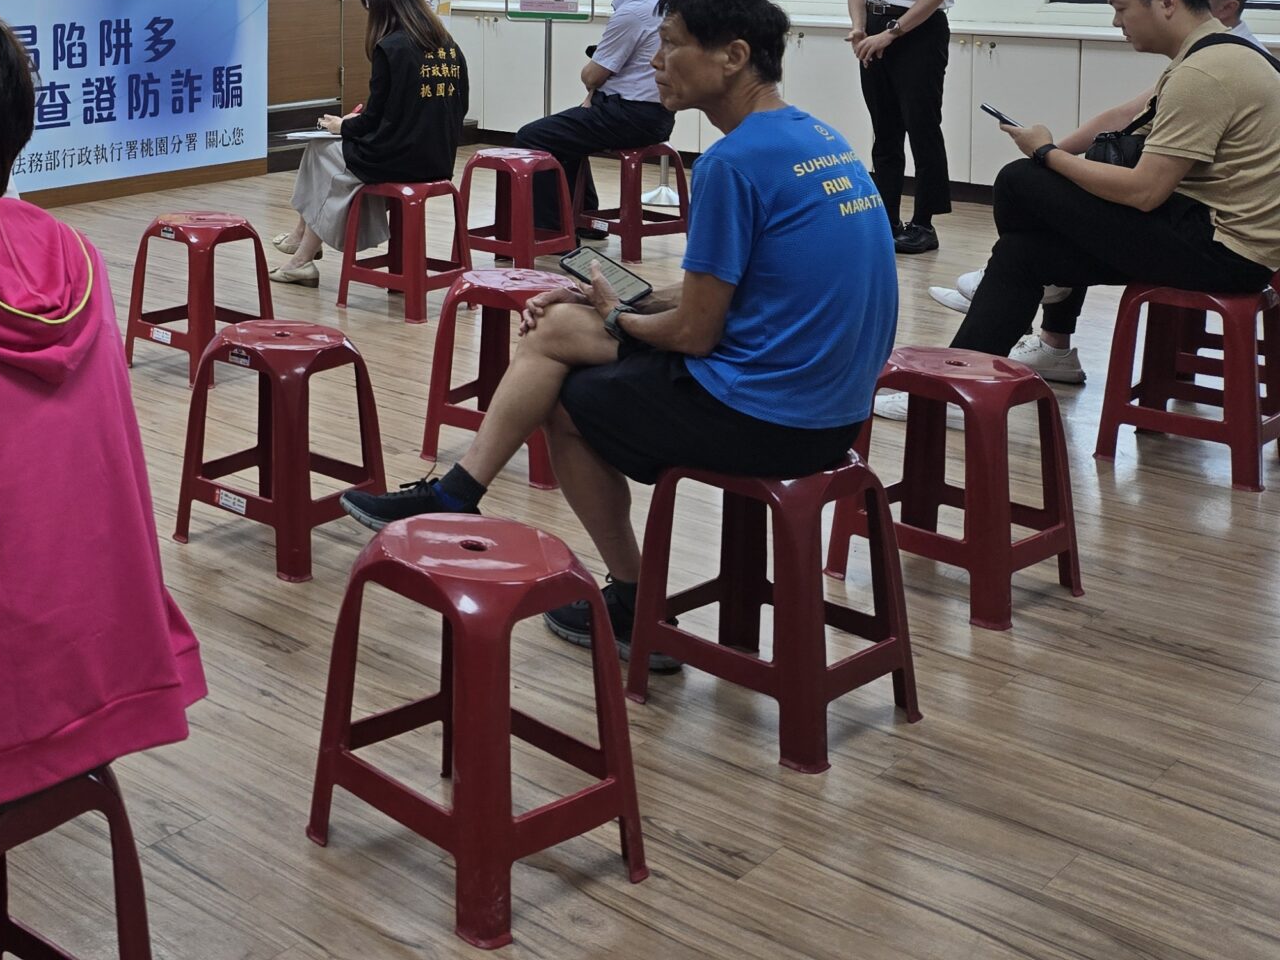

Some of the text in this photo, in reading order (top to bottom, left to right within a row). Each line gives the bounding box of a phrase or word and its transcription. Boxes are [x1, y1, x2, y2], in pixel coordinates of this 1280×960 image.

[420, 63, 460, 79] 行政執行
[34, 64, 243, 130] 查證防詐騙
[205, 127, 244, 149] 關心您
[793, 154, 840, 177] SUHUA
[822, 176, 853, 196] RUN
